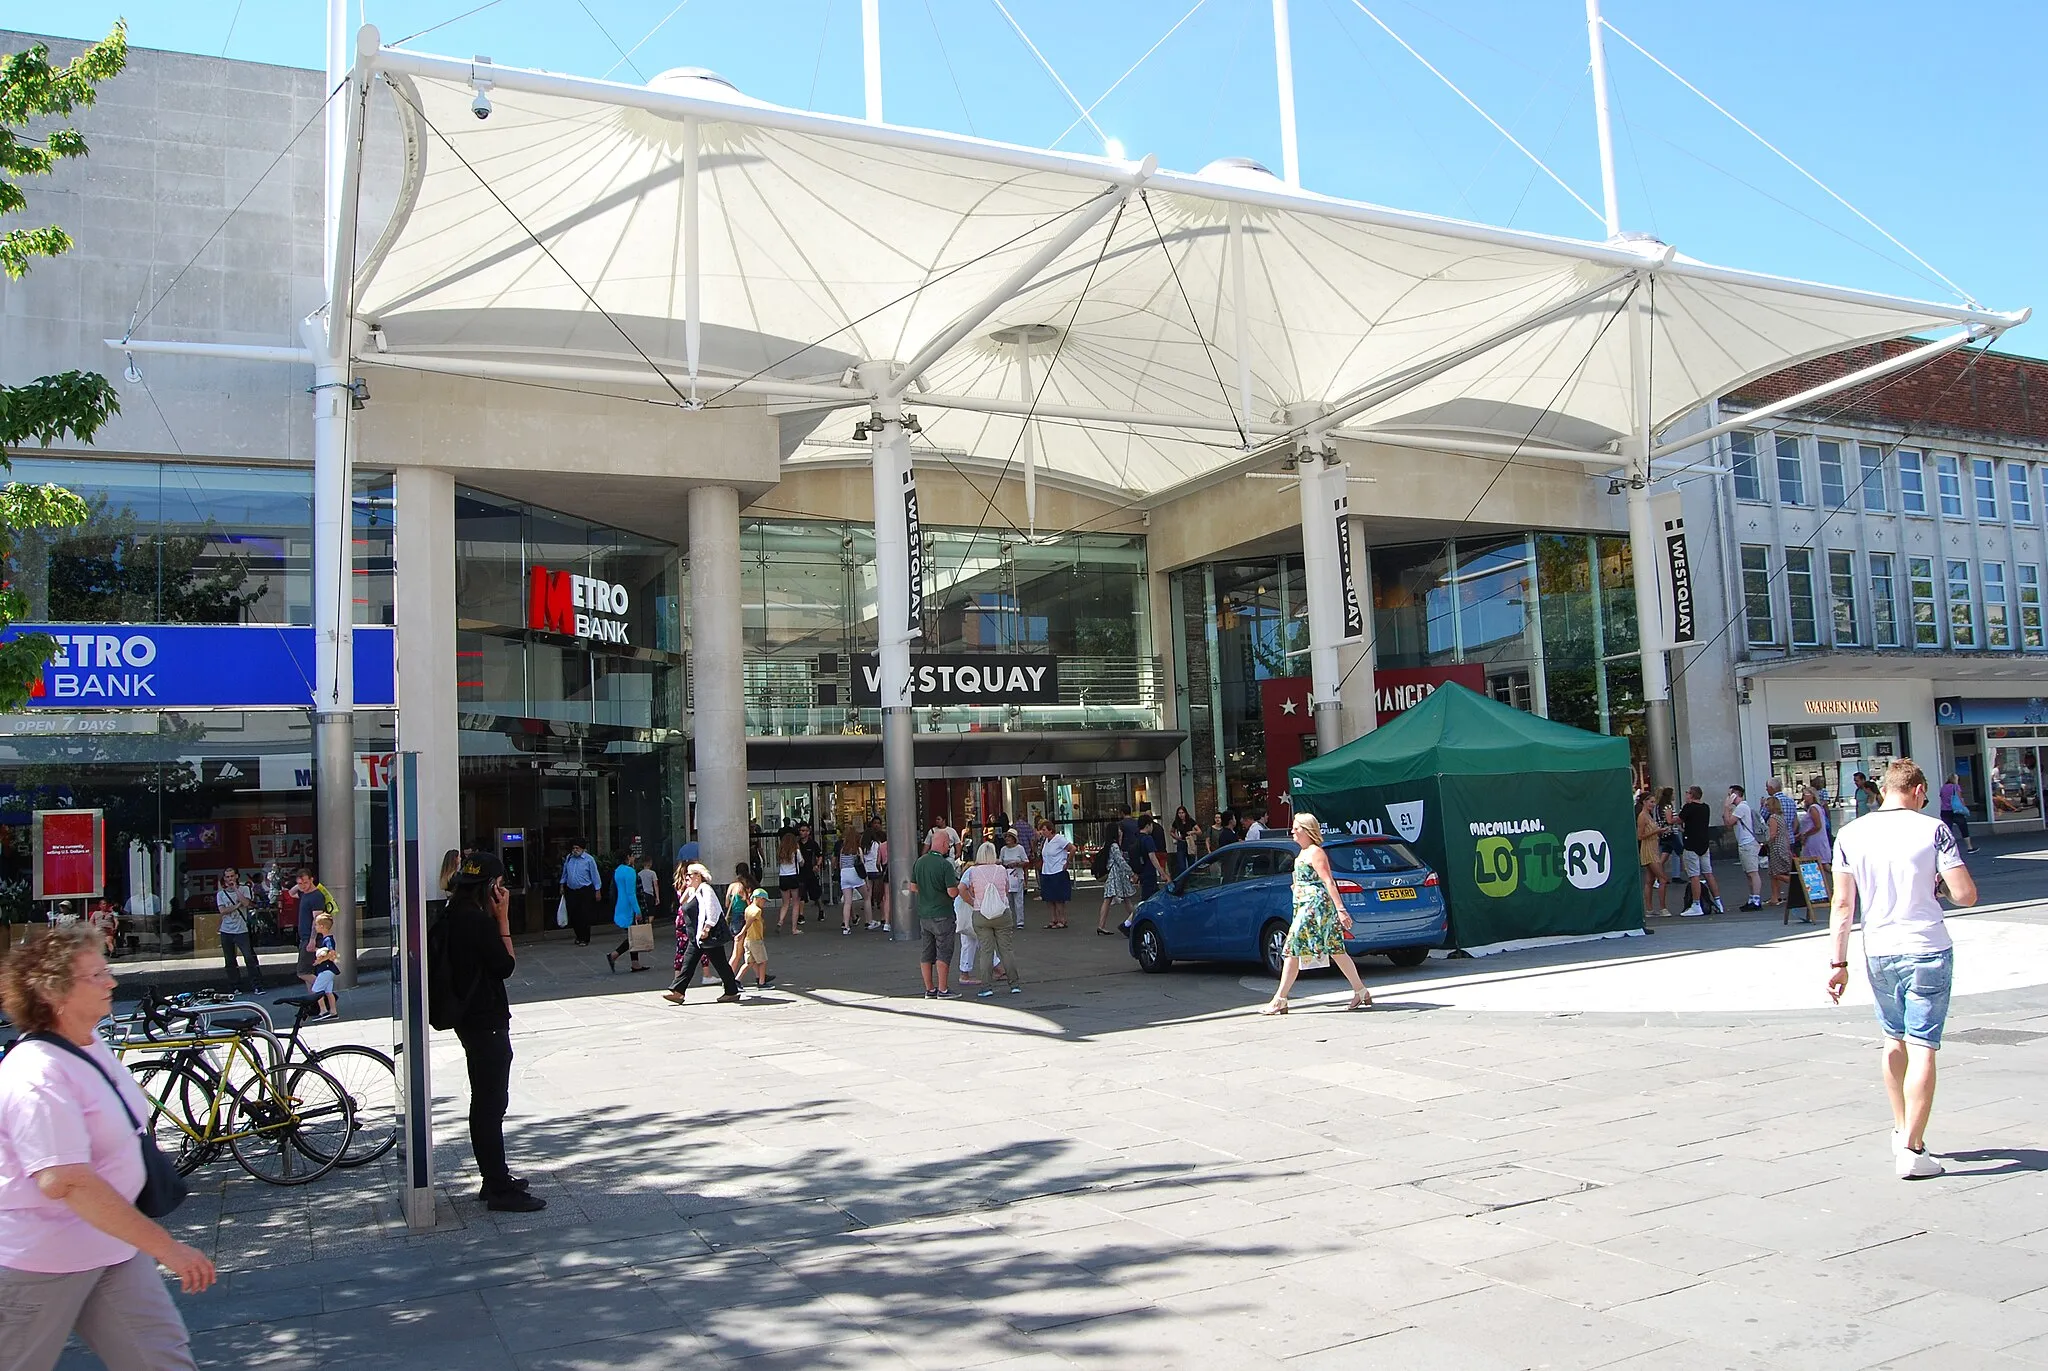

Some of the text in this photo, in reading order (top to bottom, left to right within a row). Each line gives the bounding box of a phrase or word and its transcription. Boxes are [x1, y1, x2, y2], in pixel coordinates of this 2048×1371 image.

[908, 496, 920, 621] WESTQUAY
[1672, 540, 1691, 636] WESTQUAY
[529, 566, 629, 635] METRO
[574, 614, 629, 644] BANK
[55, 674, 157, 697] BANK
[1804, 700, 1880, 714] WARREN JAMES
[14, 717, 117, 731] OPEN 7 DAYS
[1345, 818, 1383, 835] YOU
[1400, 813, 1412, 826] £1
[1470, 819, 1545, 836] MACMILLAN.
[1476, 842, 1608, 884] LOTTERY
[1379, 890, 1400, 900] EF63
